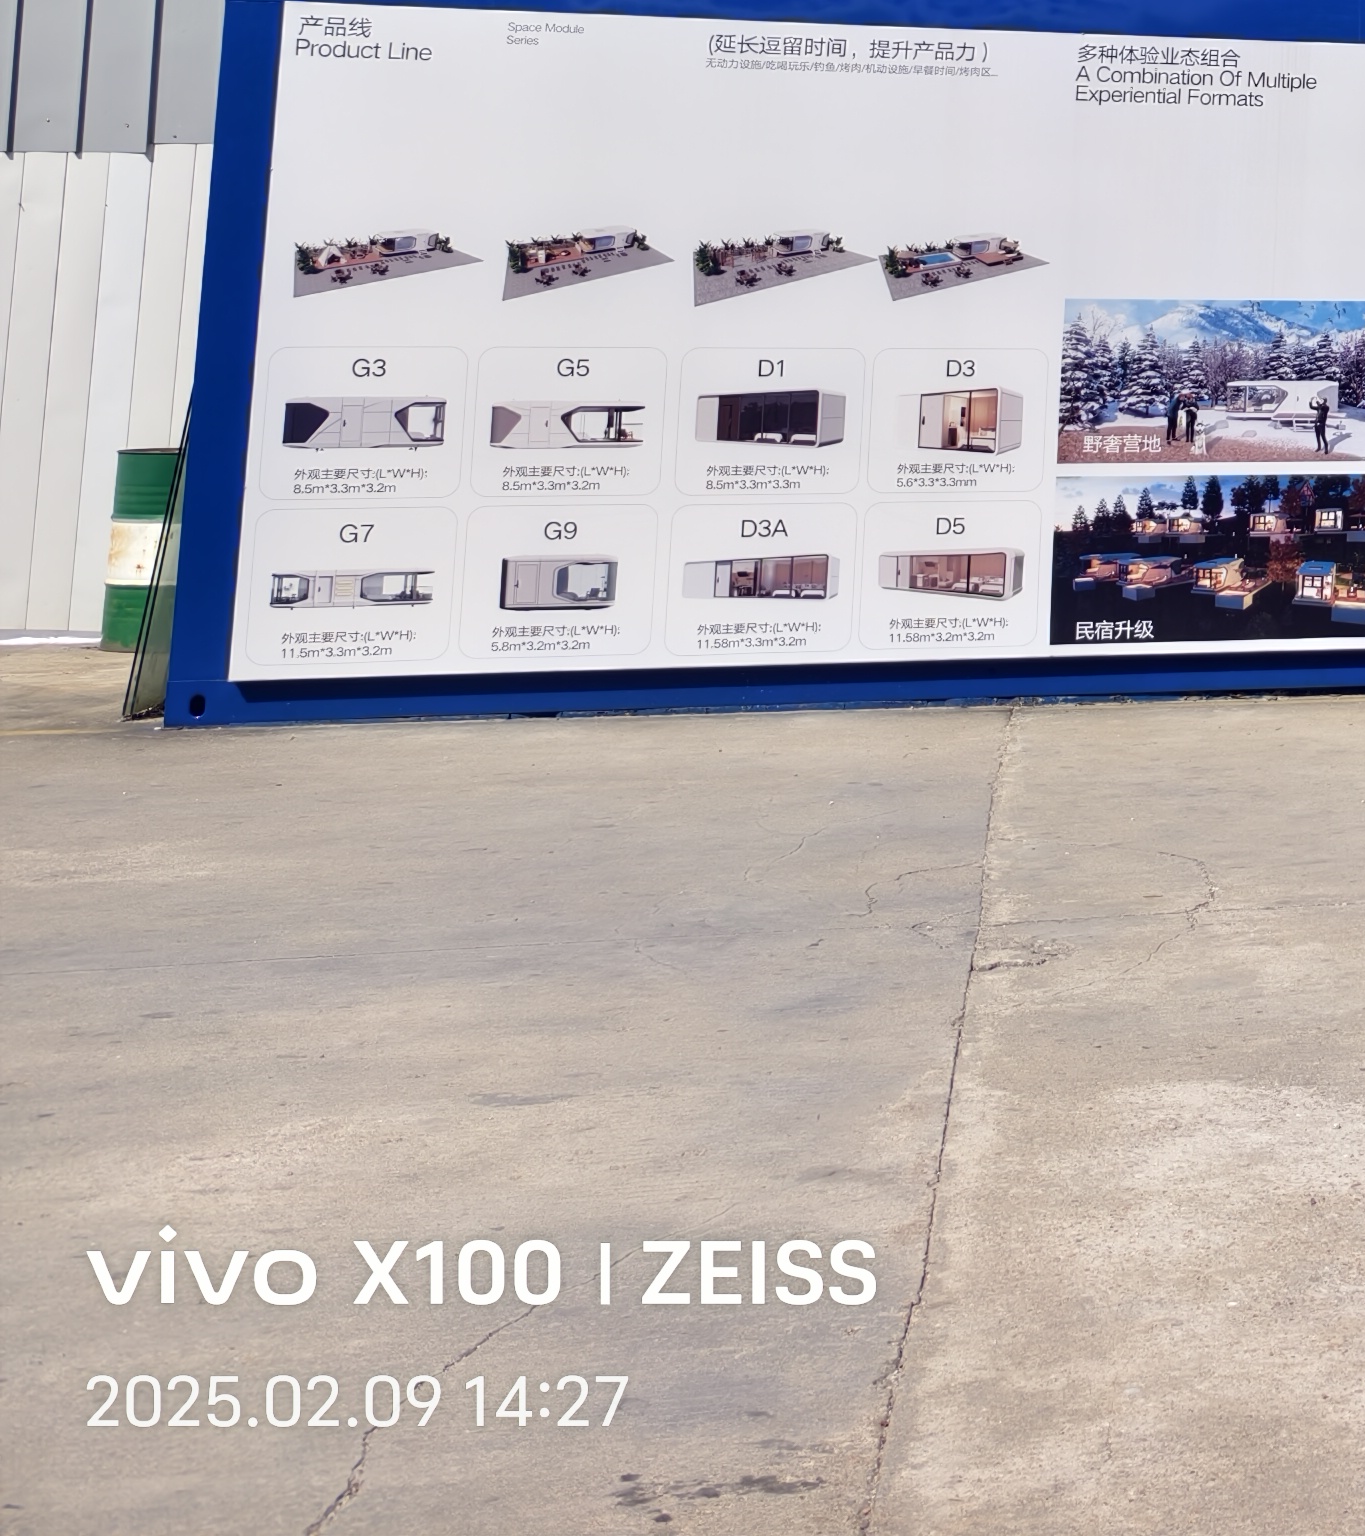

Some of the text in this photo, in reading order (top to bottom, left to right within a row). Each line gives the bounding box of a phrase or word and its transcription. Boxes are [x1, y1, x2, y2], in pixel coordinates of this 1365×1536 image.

[298, 15, 372, 38] 产品线
[507, 22, 584, 34] Space Module
[295, 38, 432, 61] Product Line
[506, 35, 539, 46] Series
[1077, 44, 1241, 67] 多种体验业态组合
[1075, 66, 1317, 92] A Combination Of Multiple
[1075, 85, 1264, 107] Experiential Formats
[352, 358, 387, 377] G3
[556, 358, 590, 377] G5
[758, 359, 785, 377] D1
[946, 360, 976, 377] D3
[1082, 434, 1162, 453] 野奢营地
[339, 524, 375, 543] G7
[543, 522, 578, 541] G9
[740, 519, 788, 538] D3A
[936, 517, 966, 536] D5
[1075, 619, 1155, 641] 民宿升级
